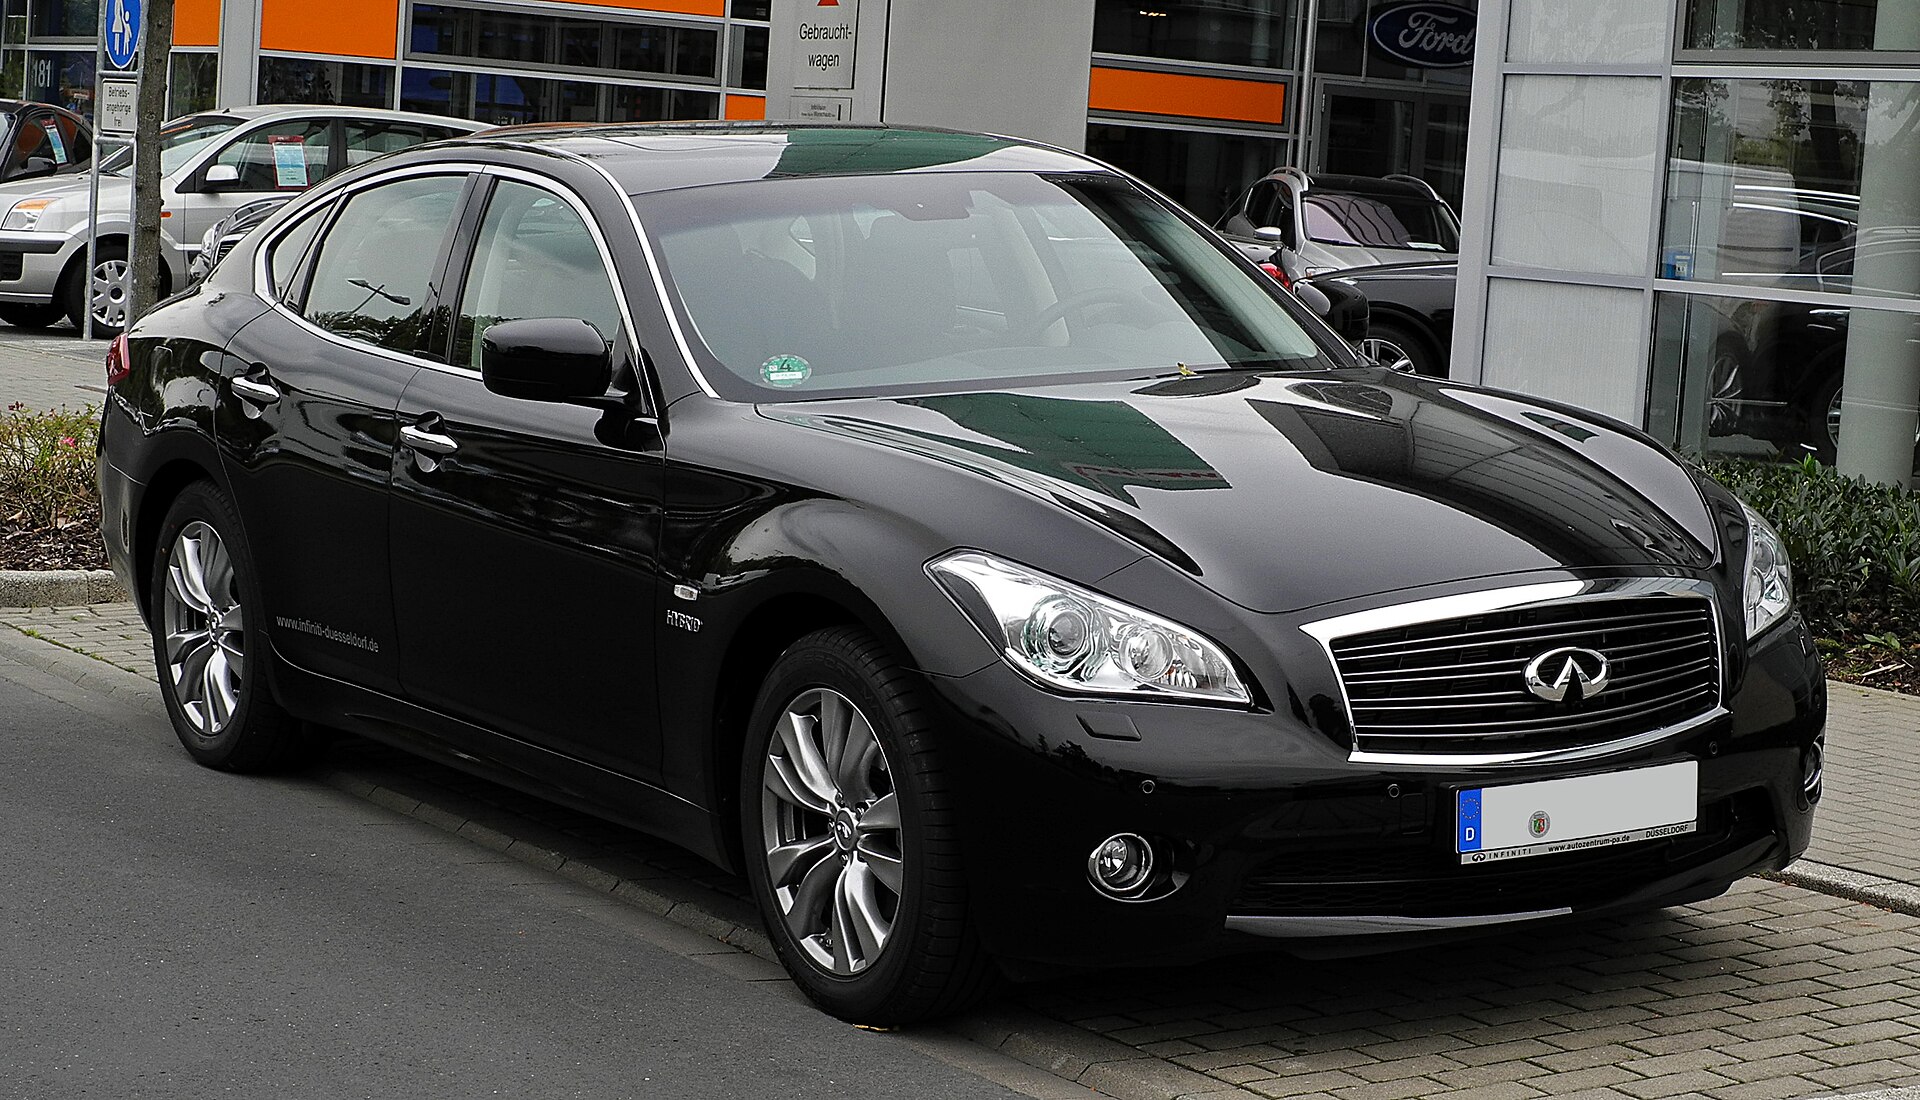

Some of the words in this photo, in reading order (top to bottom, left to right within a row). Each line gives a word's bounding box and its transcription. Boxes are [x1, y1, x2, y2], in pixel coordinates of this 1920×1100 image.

[799, 23, 852, 40] Gebraucht-
[1398, 11, 1475, 55] Ford
[808, 54, 840, 71] wagen
[33, 59, 51, 88] 181
[108, 86, 130, 98] Betriebs-
[780, 359, 792, 371] 4
[276, 616, 379, 653] www.infiniti-duesseldorf.de
[1465, 827, 1475, 841] D
[1488, 848, 1532, 859] INFINITI
[1548, 834, 1631, 852] www.autozentrum-pa.de
